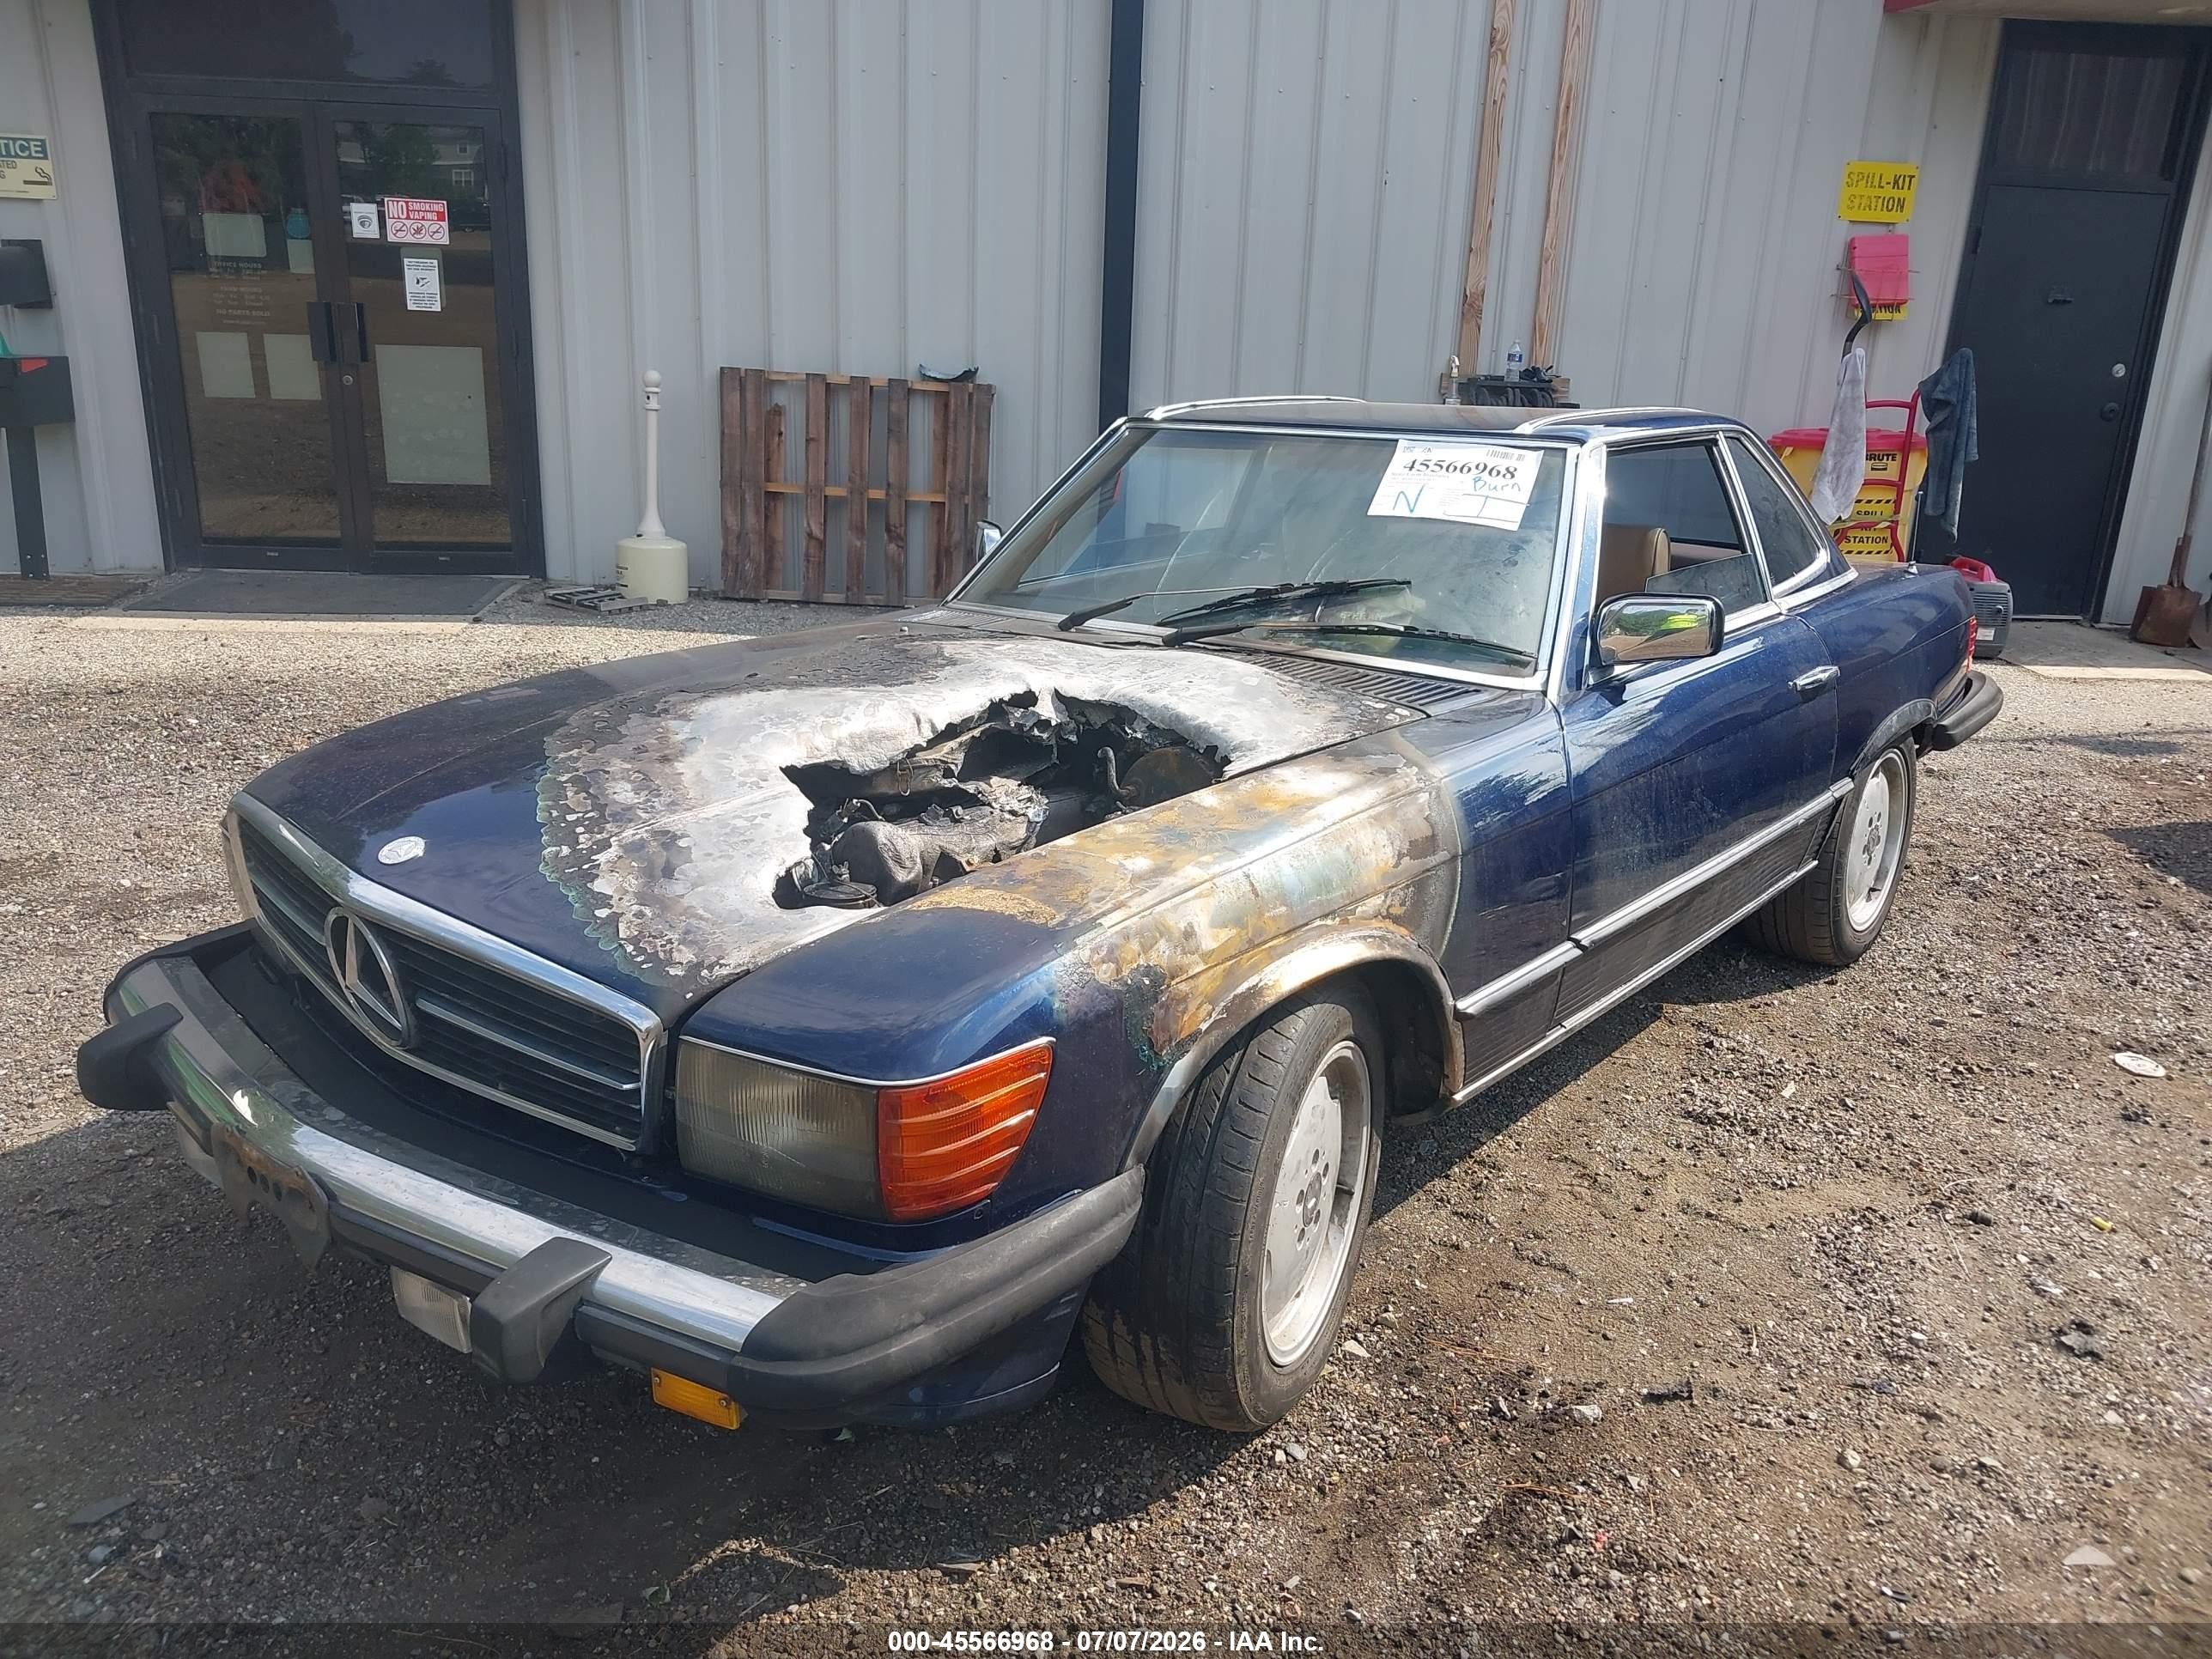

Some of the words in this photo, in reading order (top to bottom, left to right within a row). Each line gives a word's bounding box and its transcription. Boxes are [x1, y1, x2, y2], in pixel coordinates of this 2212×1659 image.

[1846, 172, 1917, 191] SPILL-KIT
[388, 200, 407, 219] NO
[408, 202, 444, 212] SMOKING
[1847, 194, 1905, 213] STATION
[409, 210, 438, 221] VAPING
[1403, 459, 1517, 480] 45566968
[1472, 476, 1521, 492] Burn
[1393, 483, 1425, 514] N
[1844, 535, 1889, 544] STATION
